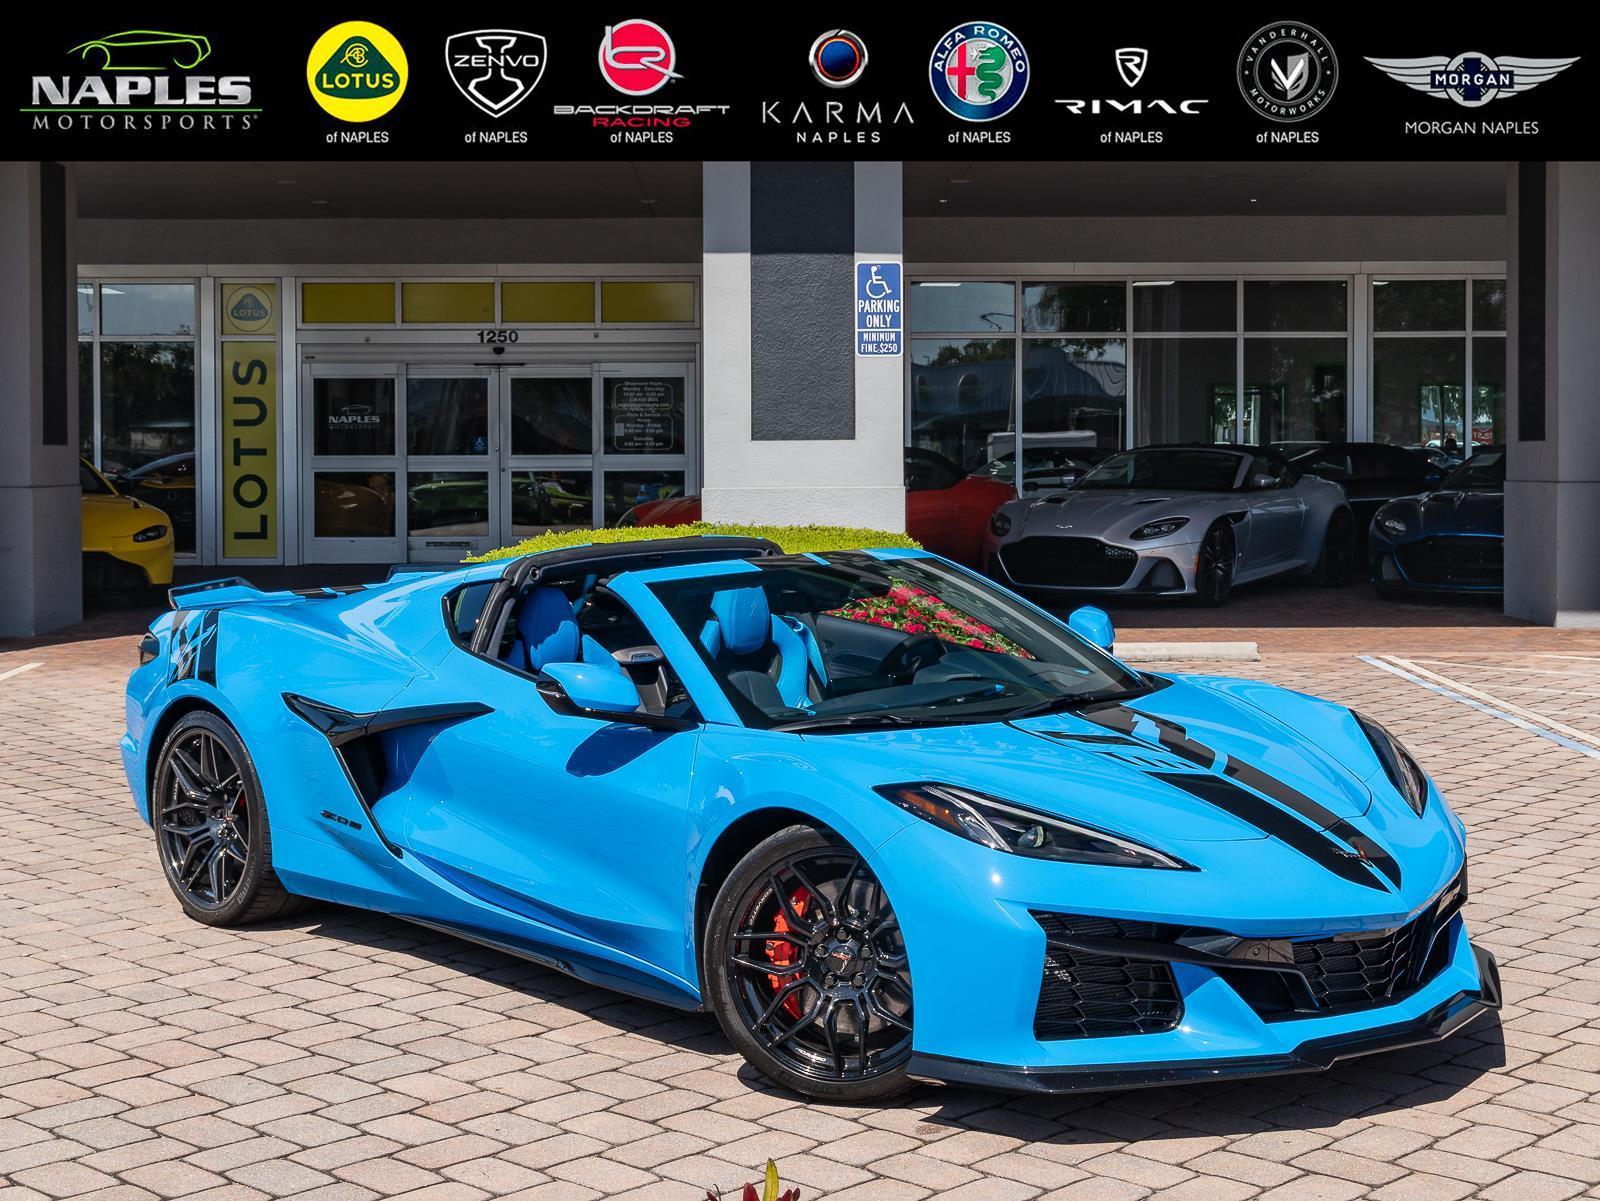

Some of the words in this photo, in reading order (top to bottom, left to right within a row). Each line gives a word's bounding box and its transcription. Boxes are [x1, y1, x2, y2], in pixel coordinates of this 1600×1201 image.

[858, 299, 900, 313] PARKING
[234, 309, 266, 317] LOTUS
[866, 314, 892, 327] ONLY
[477, 329, 519, 343] 1250
[863, 332, 896, 342] MINIMUM
[861, 343, 877, 353] FINE
[879, 343, 897, 353] $250
[328, 415, 380, 424] NAPLES
[232, 358, 268, 540] LOTUS
[320, 809, 363, 831] Z06
